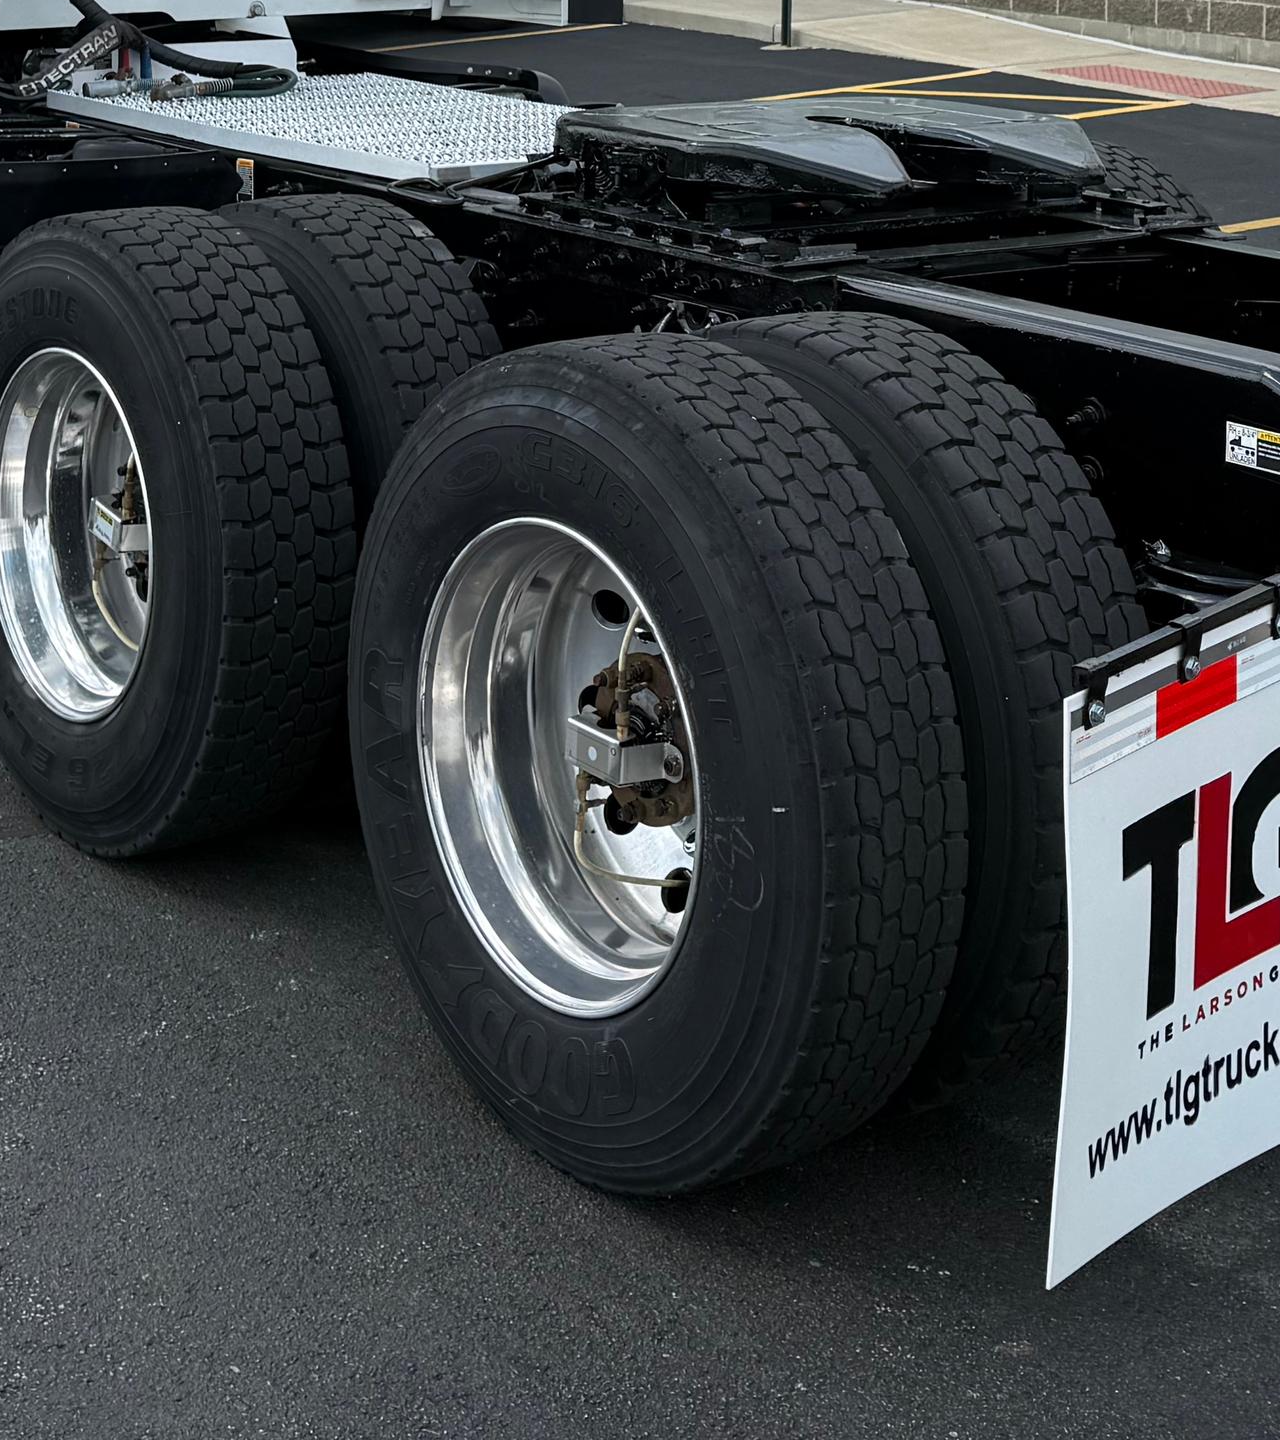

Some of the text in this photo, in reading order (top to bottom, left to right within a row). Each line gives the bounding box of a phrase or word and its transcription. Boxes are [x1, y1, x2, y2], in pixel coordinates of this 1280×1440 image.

[36, 24, 118, 89] TECTRAN
[1137, 1025, 1175, 1060] THE
[1181, 973, 1265, 1033] LARSON
